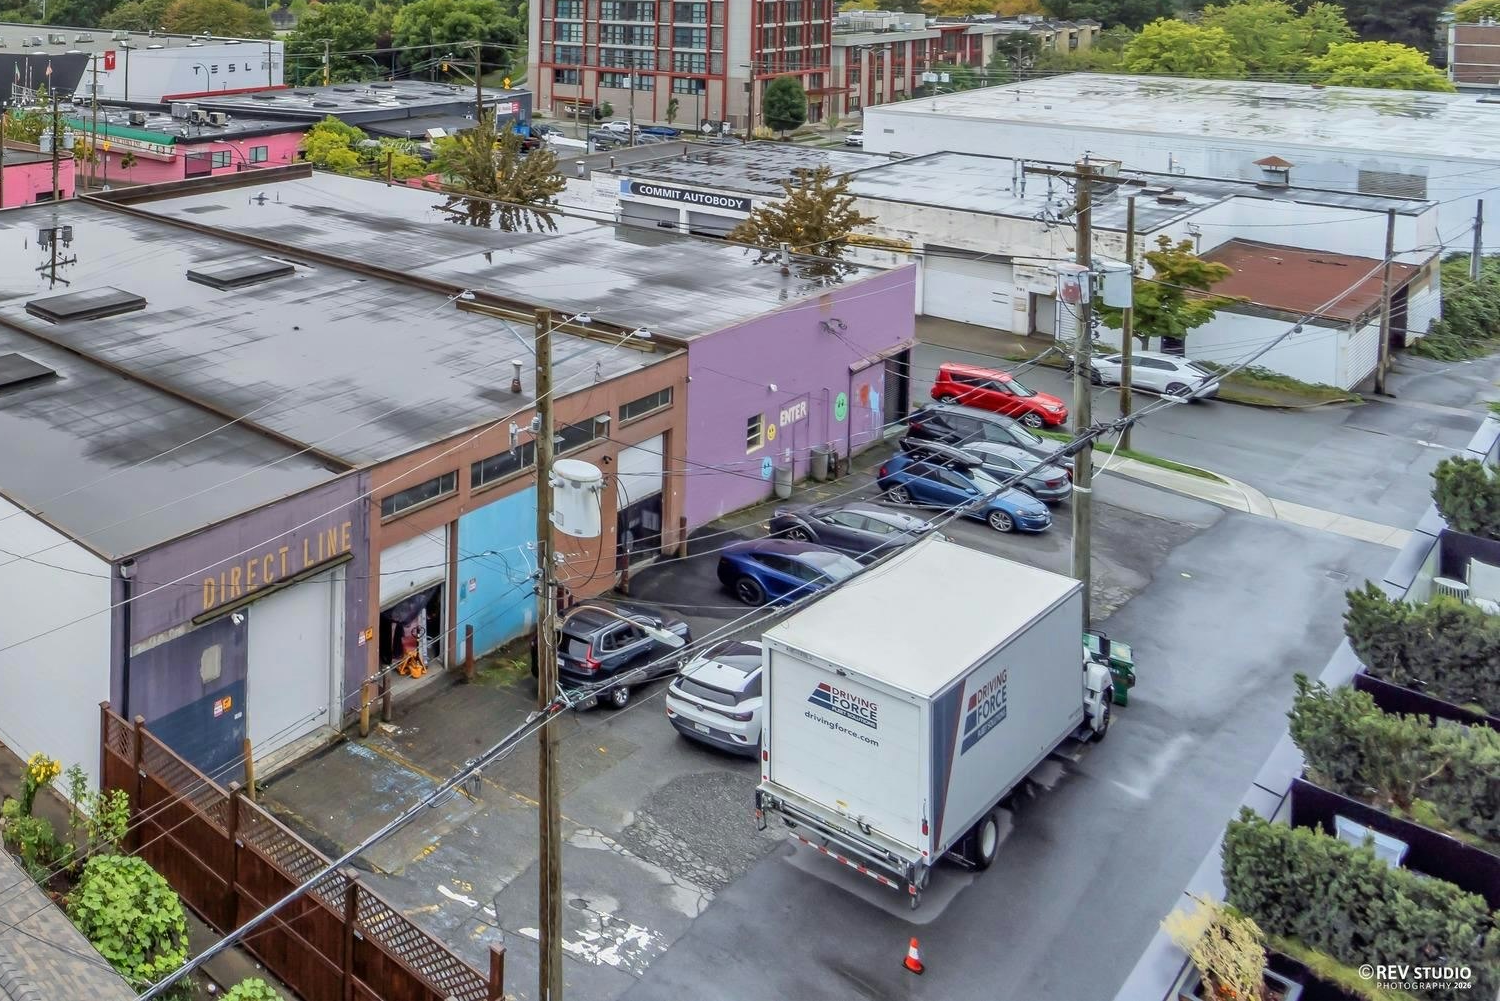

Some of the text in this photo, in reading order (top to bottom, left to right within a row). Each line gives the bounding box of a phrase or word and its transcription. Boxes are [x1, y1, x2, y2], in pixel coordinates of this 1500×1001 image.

[639, 185, 744, 209] COMMIT AUTOBODY
[779, 401, 807, 427] ENTER
[203, 521, 352, 610] DIRECT LINE
[831, 687, 878, 711] DRIVING
[977, 669, 1007, 703] DRIVING
[832, 695, 878, 721] FORCE
[977, 685, 1007, 723] FORCE
[804, 711, 879, 747] drivingforce.com
